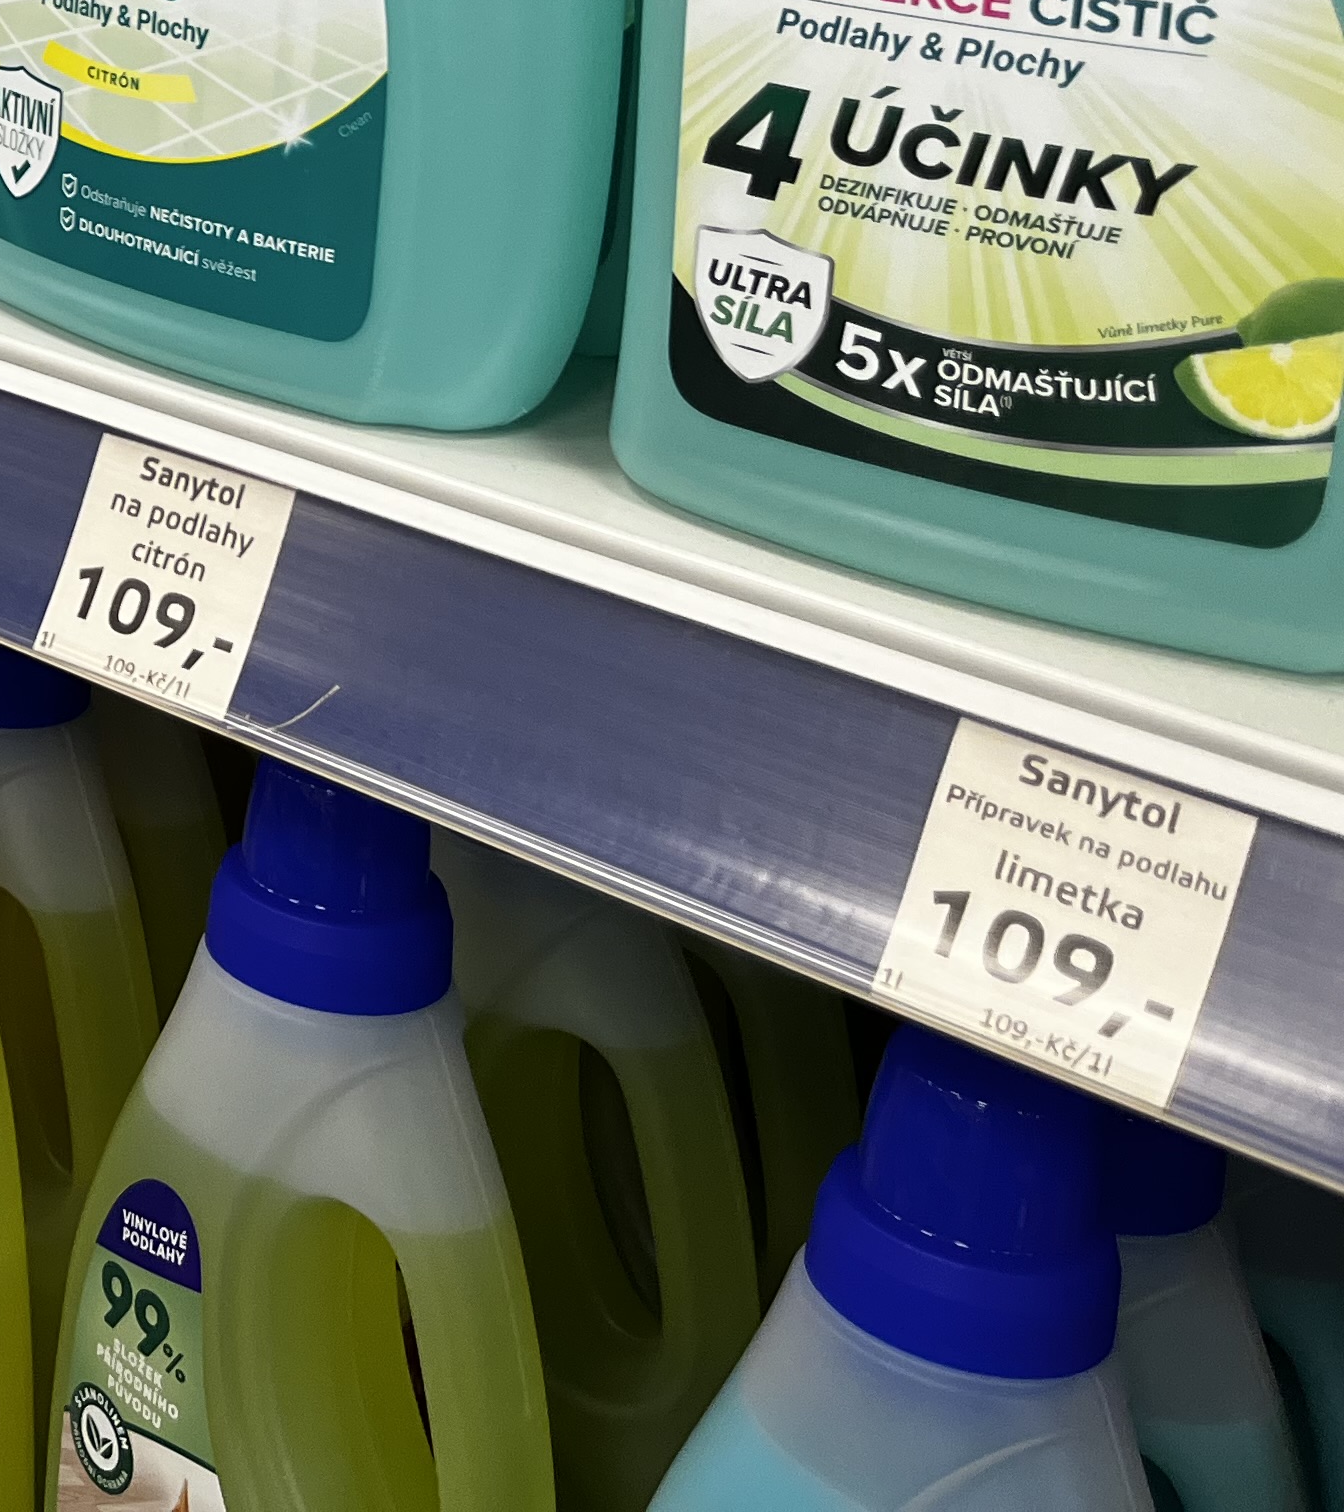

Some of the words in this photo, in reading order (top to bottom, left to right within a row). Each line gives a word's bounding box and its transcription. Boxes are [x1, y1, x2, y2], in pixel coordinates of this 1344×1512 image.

[117, 5, 132, 26] &
[137, 9, 210, 51] Plochy
[776, 7, 912, 61] Podlahy
[919, 32, 944, 60] &
[955, 38, 1086, 89] Plochy
[86, 64, 141, 92] CITRÓN
[702, 81, 811, 201] 4
[829, 84, 1199, 219] ÚČINKY
[80, 184, 146, 217] Odstraňuje
[150, 204, 234, 243] NEČISTOTY
[253, 233, 335, 264] BAKTERIE
[817, 194, 948, 238] ODVÁPŇUJE
[965, 223, 1077, 260] PROVONÍ
[819, 174, 957, 215] DEZINFIKUJE
[974, 201, 1122, 245] ODMAŠŤUJE
[79, 217, 199, 268] DLOUHOTRVAJÍCÍ
[201, 255, 257, 282] svěžest
[708, 258, 813, 309] ULTRA
[710, 290, 795, 344] SÍLA
[1139, 318, 1188, 337] limetky
[1190, 312, 1224, 330] Pure
[936, 358, 1156, 404] ODMAŠŤUJÍCÍ
[942, 347, 973, 362] VĚTŠÍ
[140, 456, 246, 509] Sanytol
[110, 492, 141, 518] na
[147, 505, 255, 558] podlahy
[131, 540, 206, 582] citrón
[77, 566, 234, 671] 109,-
[1019, 753, 1182, 835] Sanytol
[945, 783, 1072, 846] Přípravek
[1079, 834, 1111, 860] na
[1117, 847, 1228, 902] podlahu
[994, 849, 1145, 931] limetka
[933, 889, 1175, 1039] 109,-
[121, 1207, 188, 1251] VINYLOVÉ
[121, 1225, 186, 1266] PODLAHY
[101, 1260, 187, 1384] 99%
[95, 1342, 180, 1422] PŘÍRODNÍHO
[112, 1338, 163, 1388] SLOŽEK
[106, 1374, 163, 1431] PŮVODU
